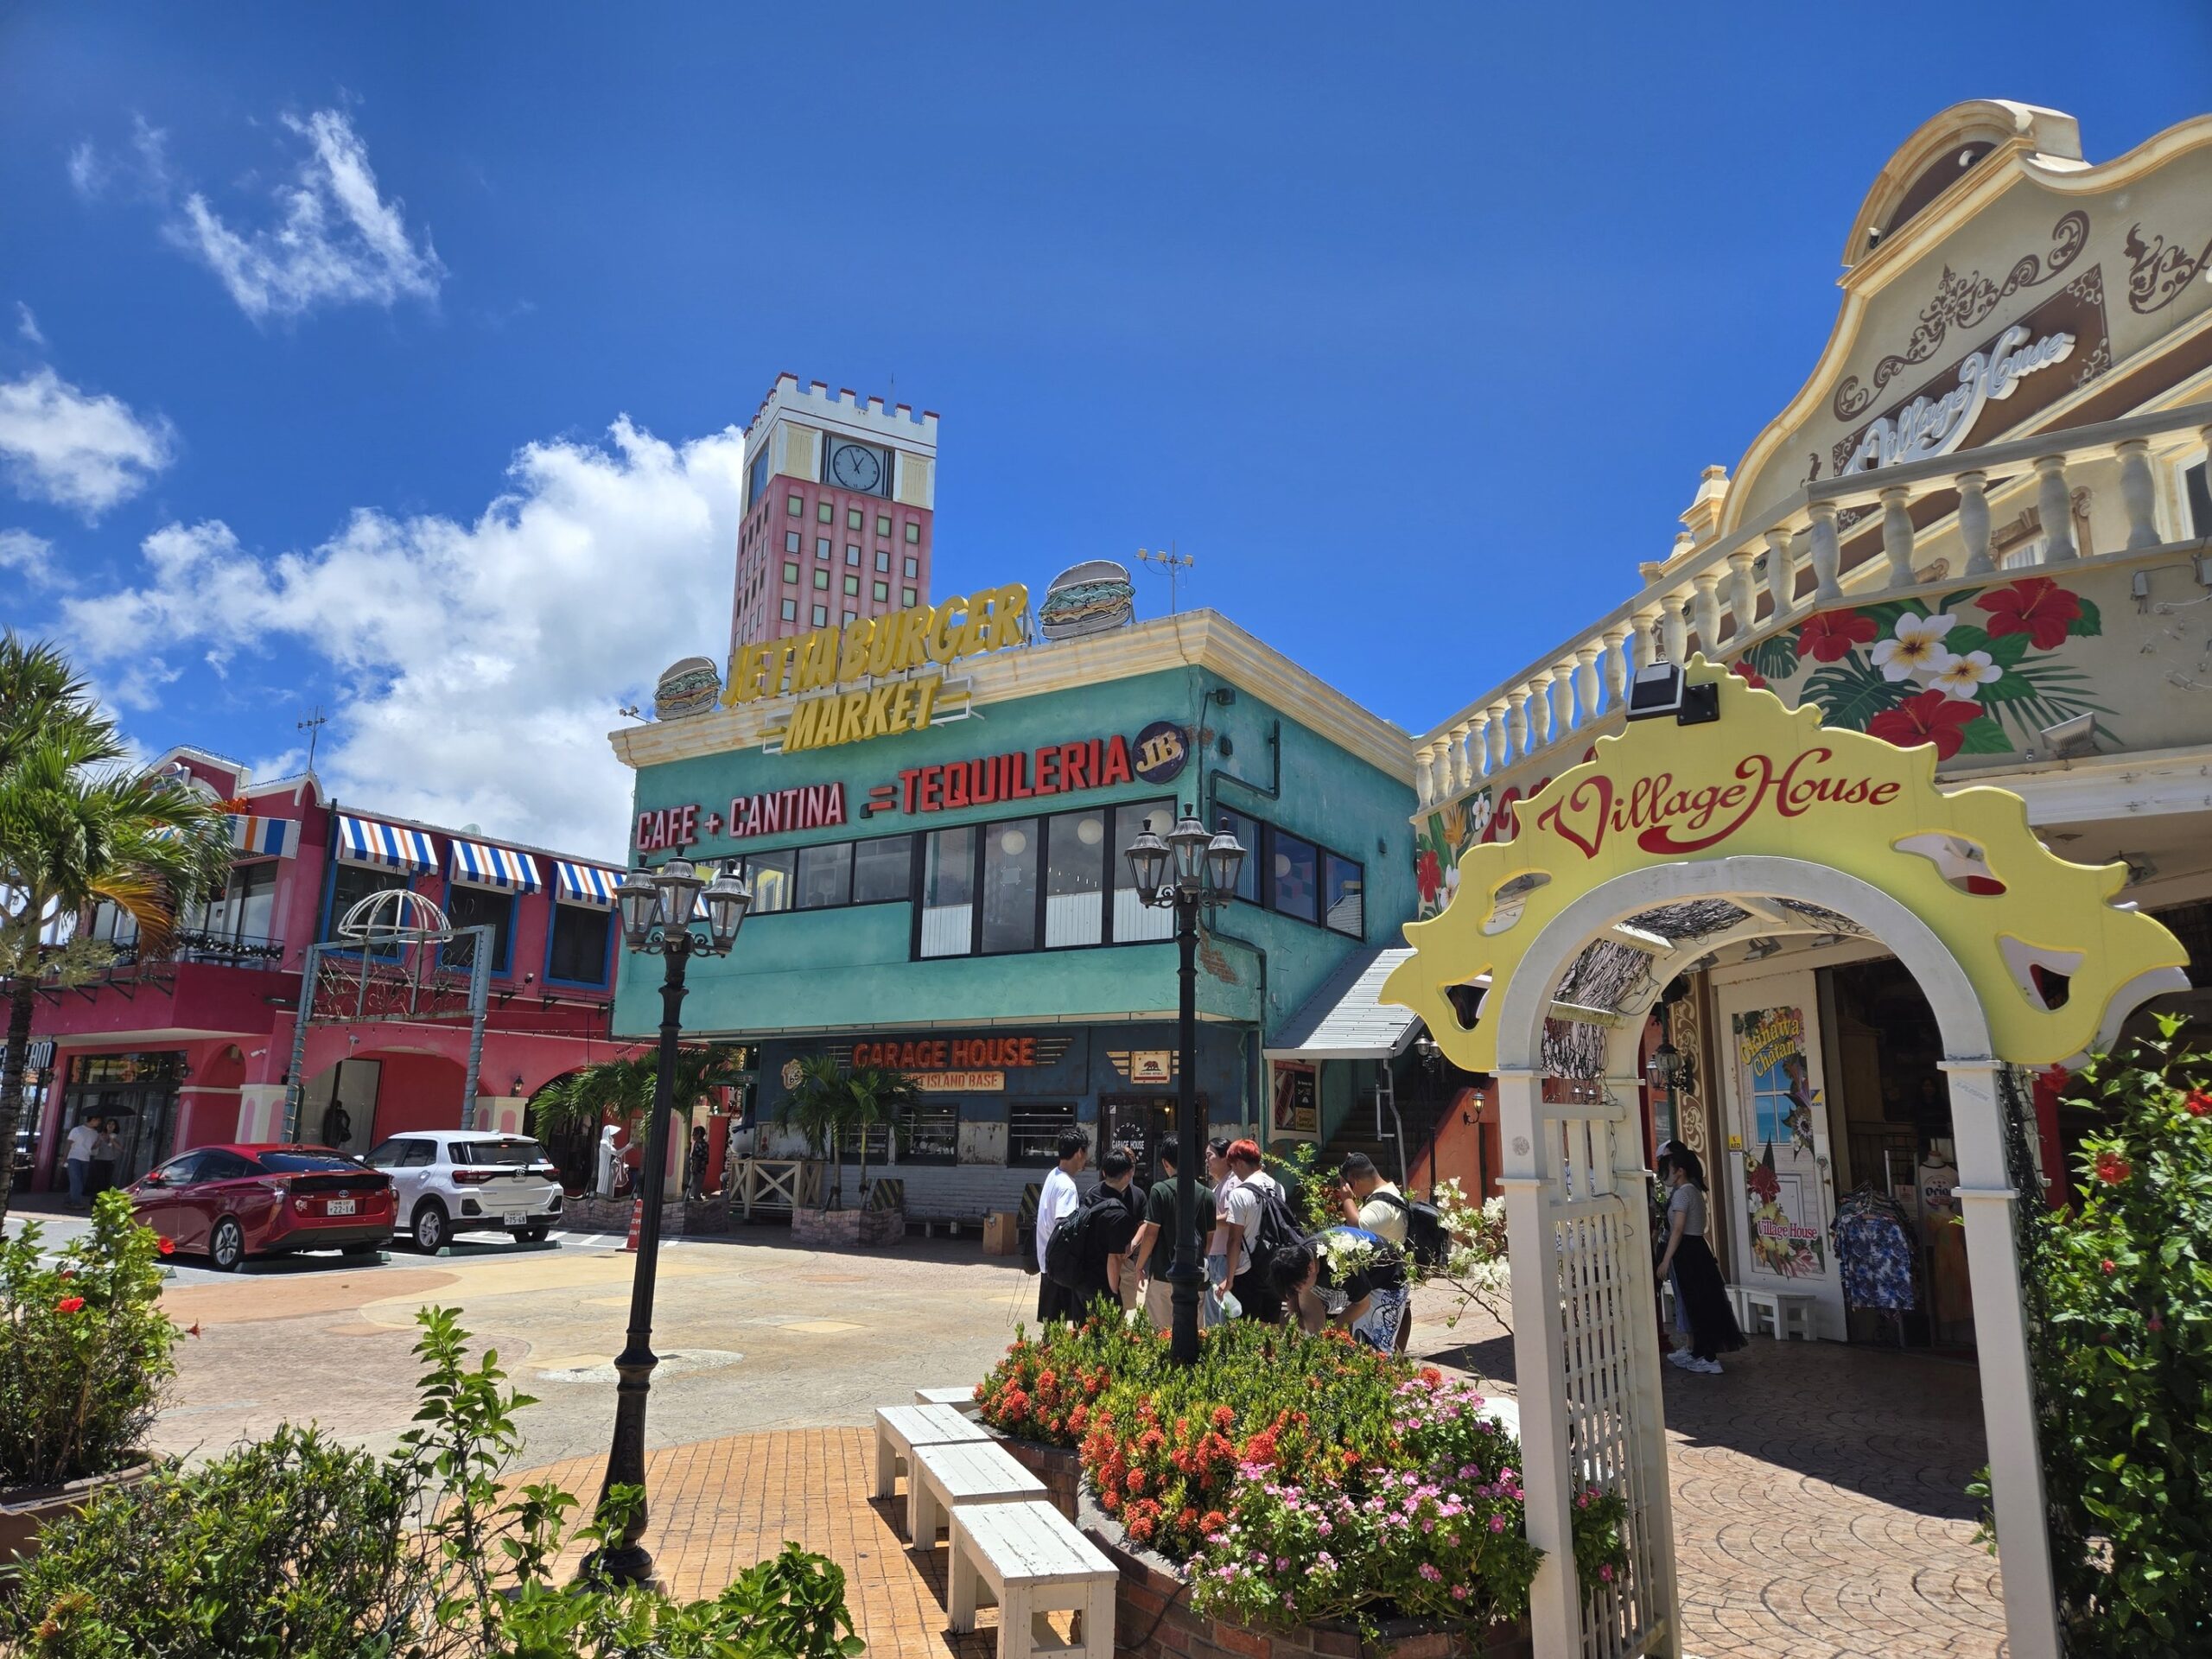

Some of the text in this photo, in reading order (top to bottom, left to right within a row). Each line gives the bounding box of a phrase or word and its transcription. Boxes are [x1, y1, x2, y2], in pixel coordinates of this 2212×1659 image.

[781, 676, 944, 754] MARKET
[636, 804, 700, 851] CAFE
[728, 782, 846, 839] CANTINA
[899, 734, 1134, 814] TEQUILERIA
[1538, 772, 1747, 860] Village
[852, 1038, 1037, 1068] GARAGE HOUSE
[1740, 1020, 1801, 1065] Okinawa
[1754, 1039, 1796, 1077] Chatan
[926, 1073, 965, 1089] ISLAND
[969, 1072, 998, 1088] BASE
[1111, 1140, 1145, 1150] GARAGE HOUSE
[1925, 1185, 1952, 1197] Orio
[1758, 1220, 1818, 1240] Village House
